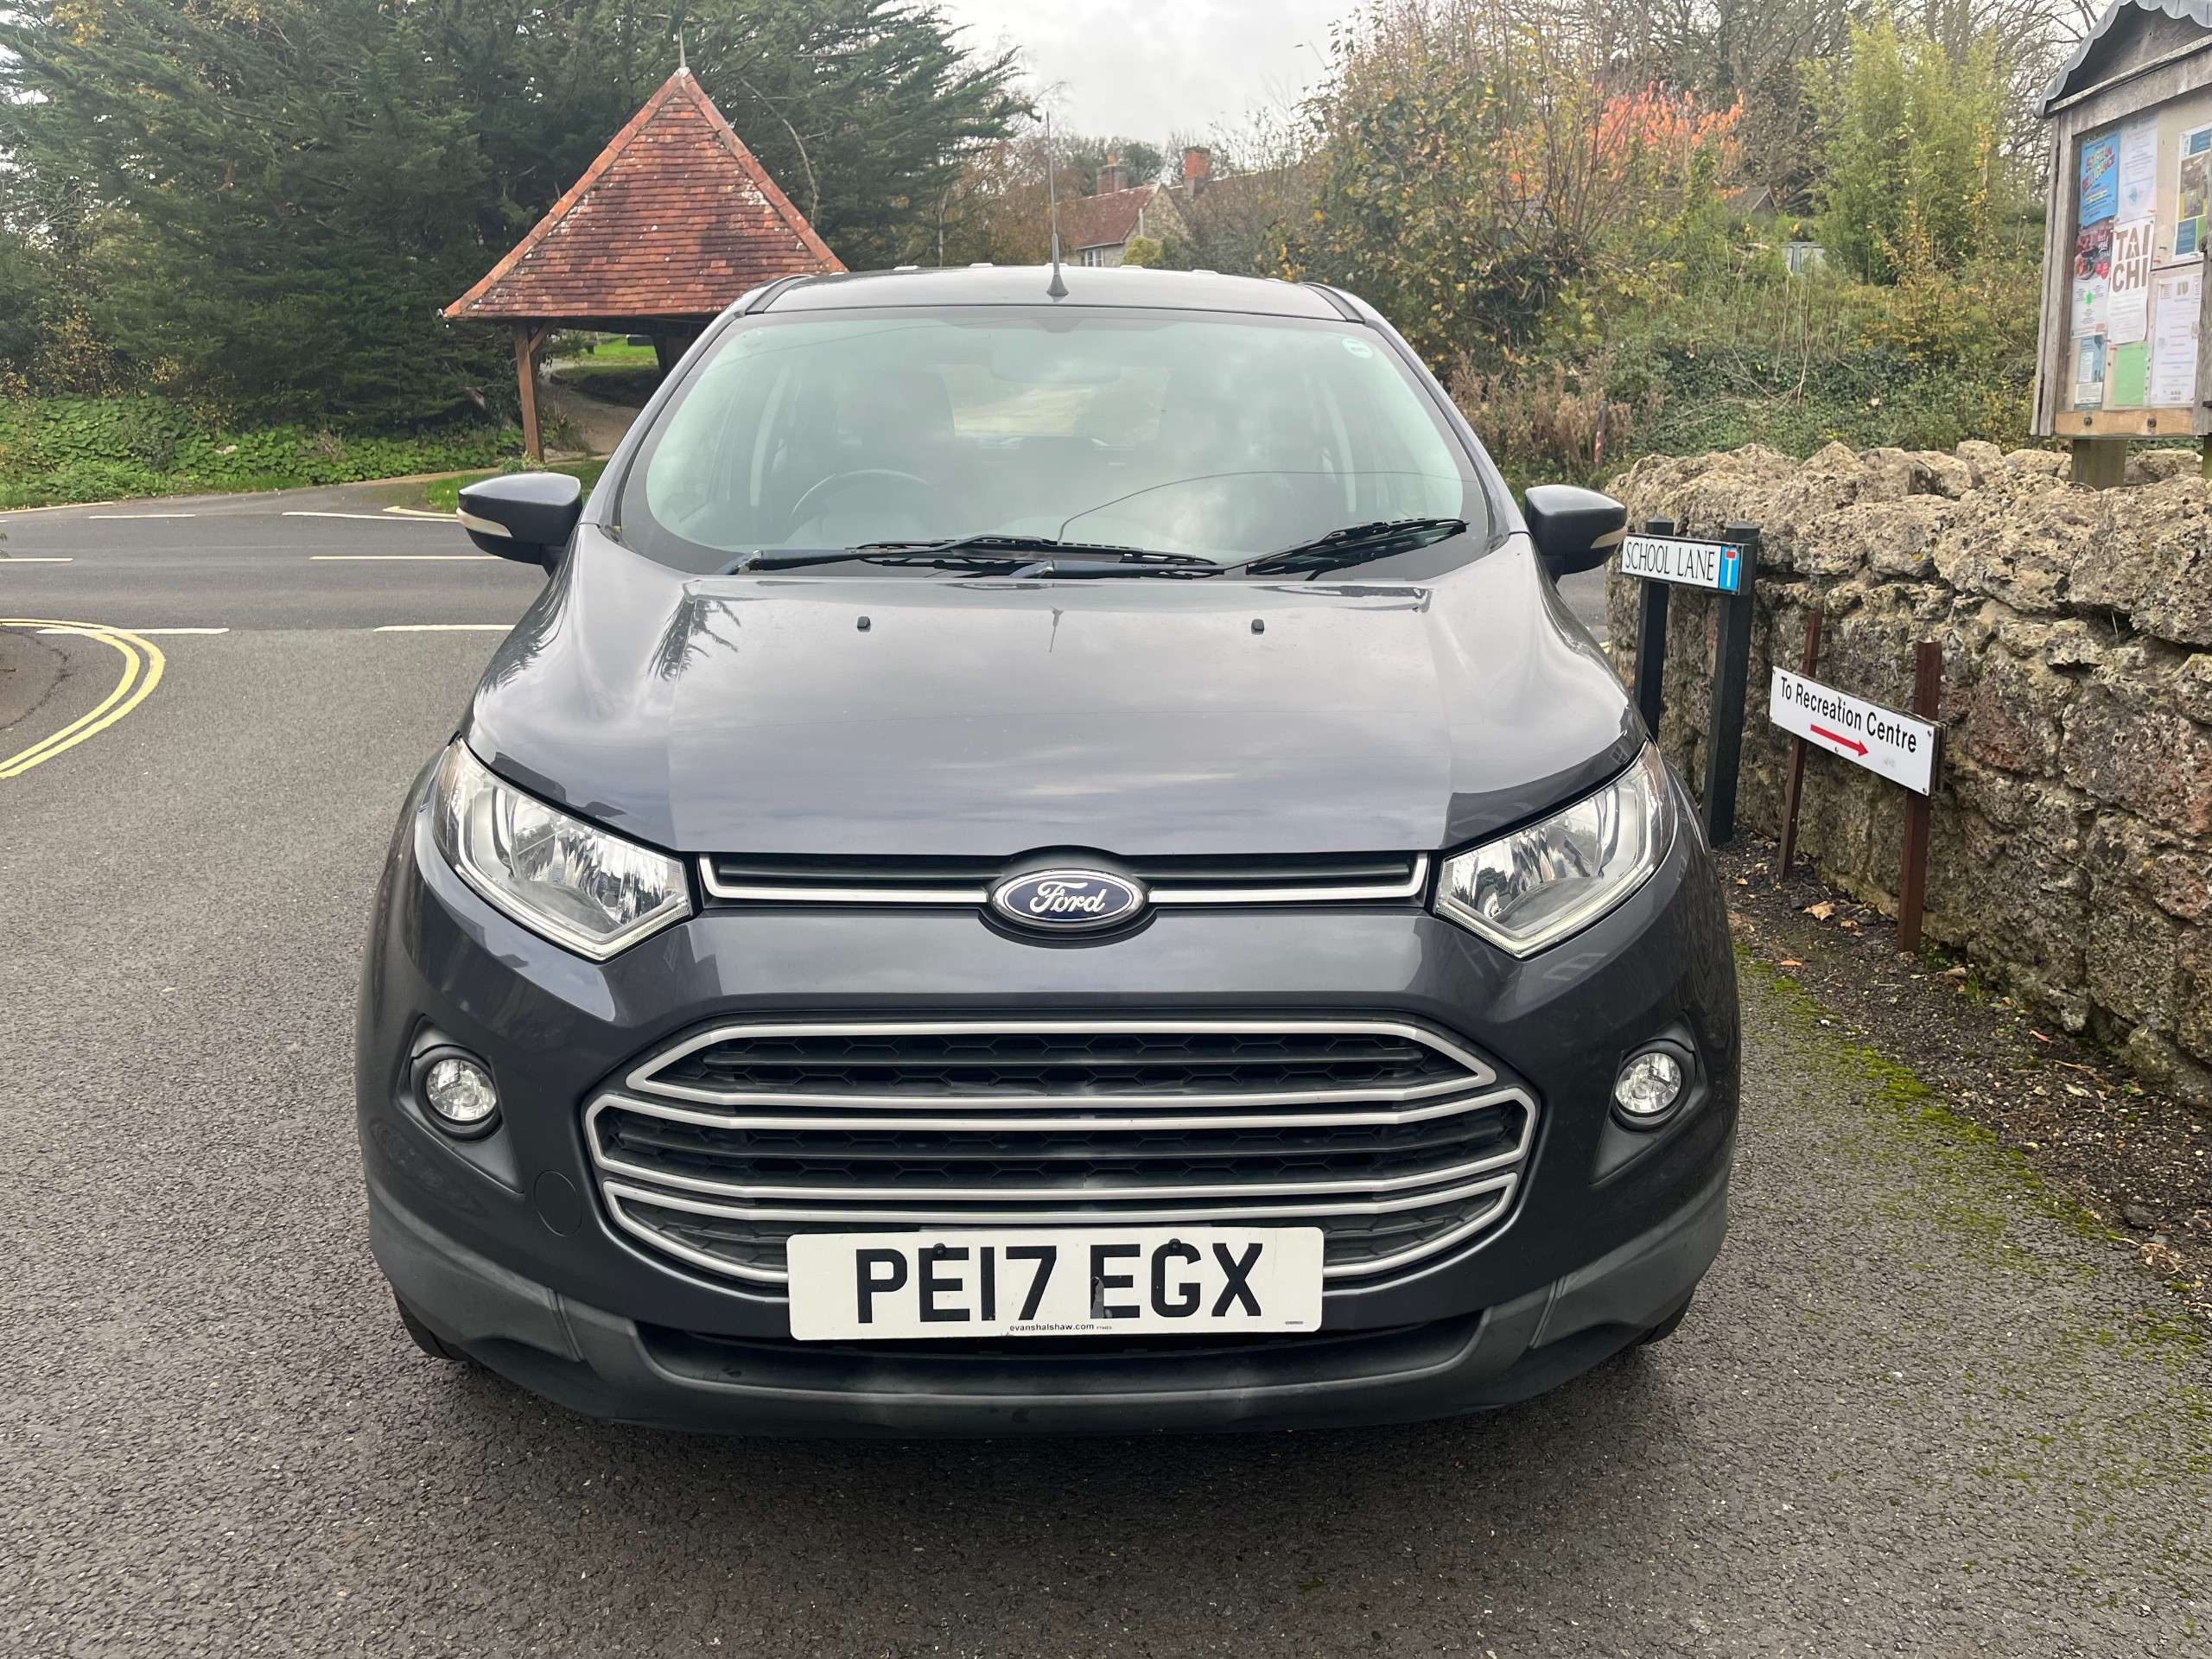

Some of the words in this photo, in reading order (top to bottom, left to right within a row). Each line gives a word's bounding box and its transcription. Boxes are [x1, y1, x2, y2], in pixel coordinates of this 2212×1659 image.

[2116, 225, 2151, 262] TAI
[2112, 257, 2149, 292] CHI
[1625, 541, 1670, 575] SCHOOL
[1676, 547, 1715, 582] LANE
[1781, 677, 1792, 701] To
[1796, 683, 1862, 732] Recreation
[1866, 712, 1916, 753] Centre
[1029, 880, 1107, 913] Ford
[855, 1244, 1058, 1324] PE17
[1090, 1242, 1263, 1319] EGX
[1009, 1322, 1095, 1332] evanshalshaw.com
